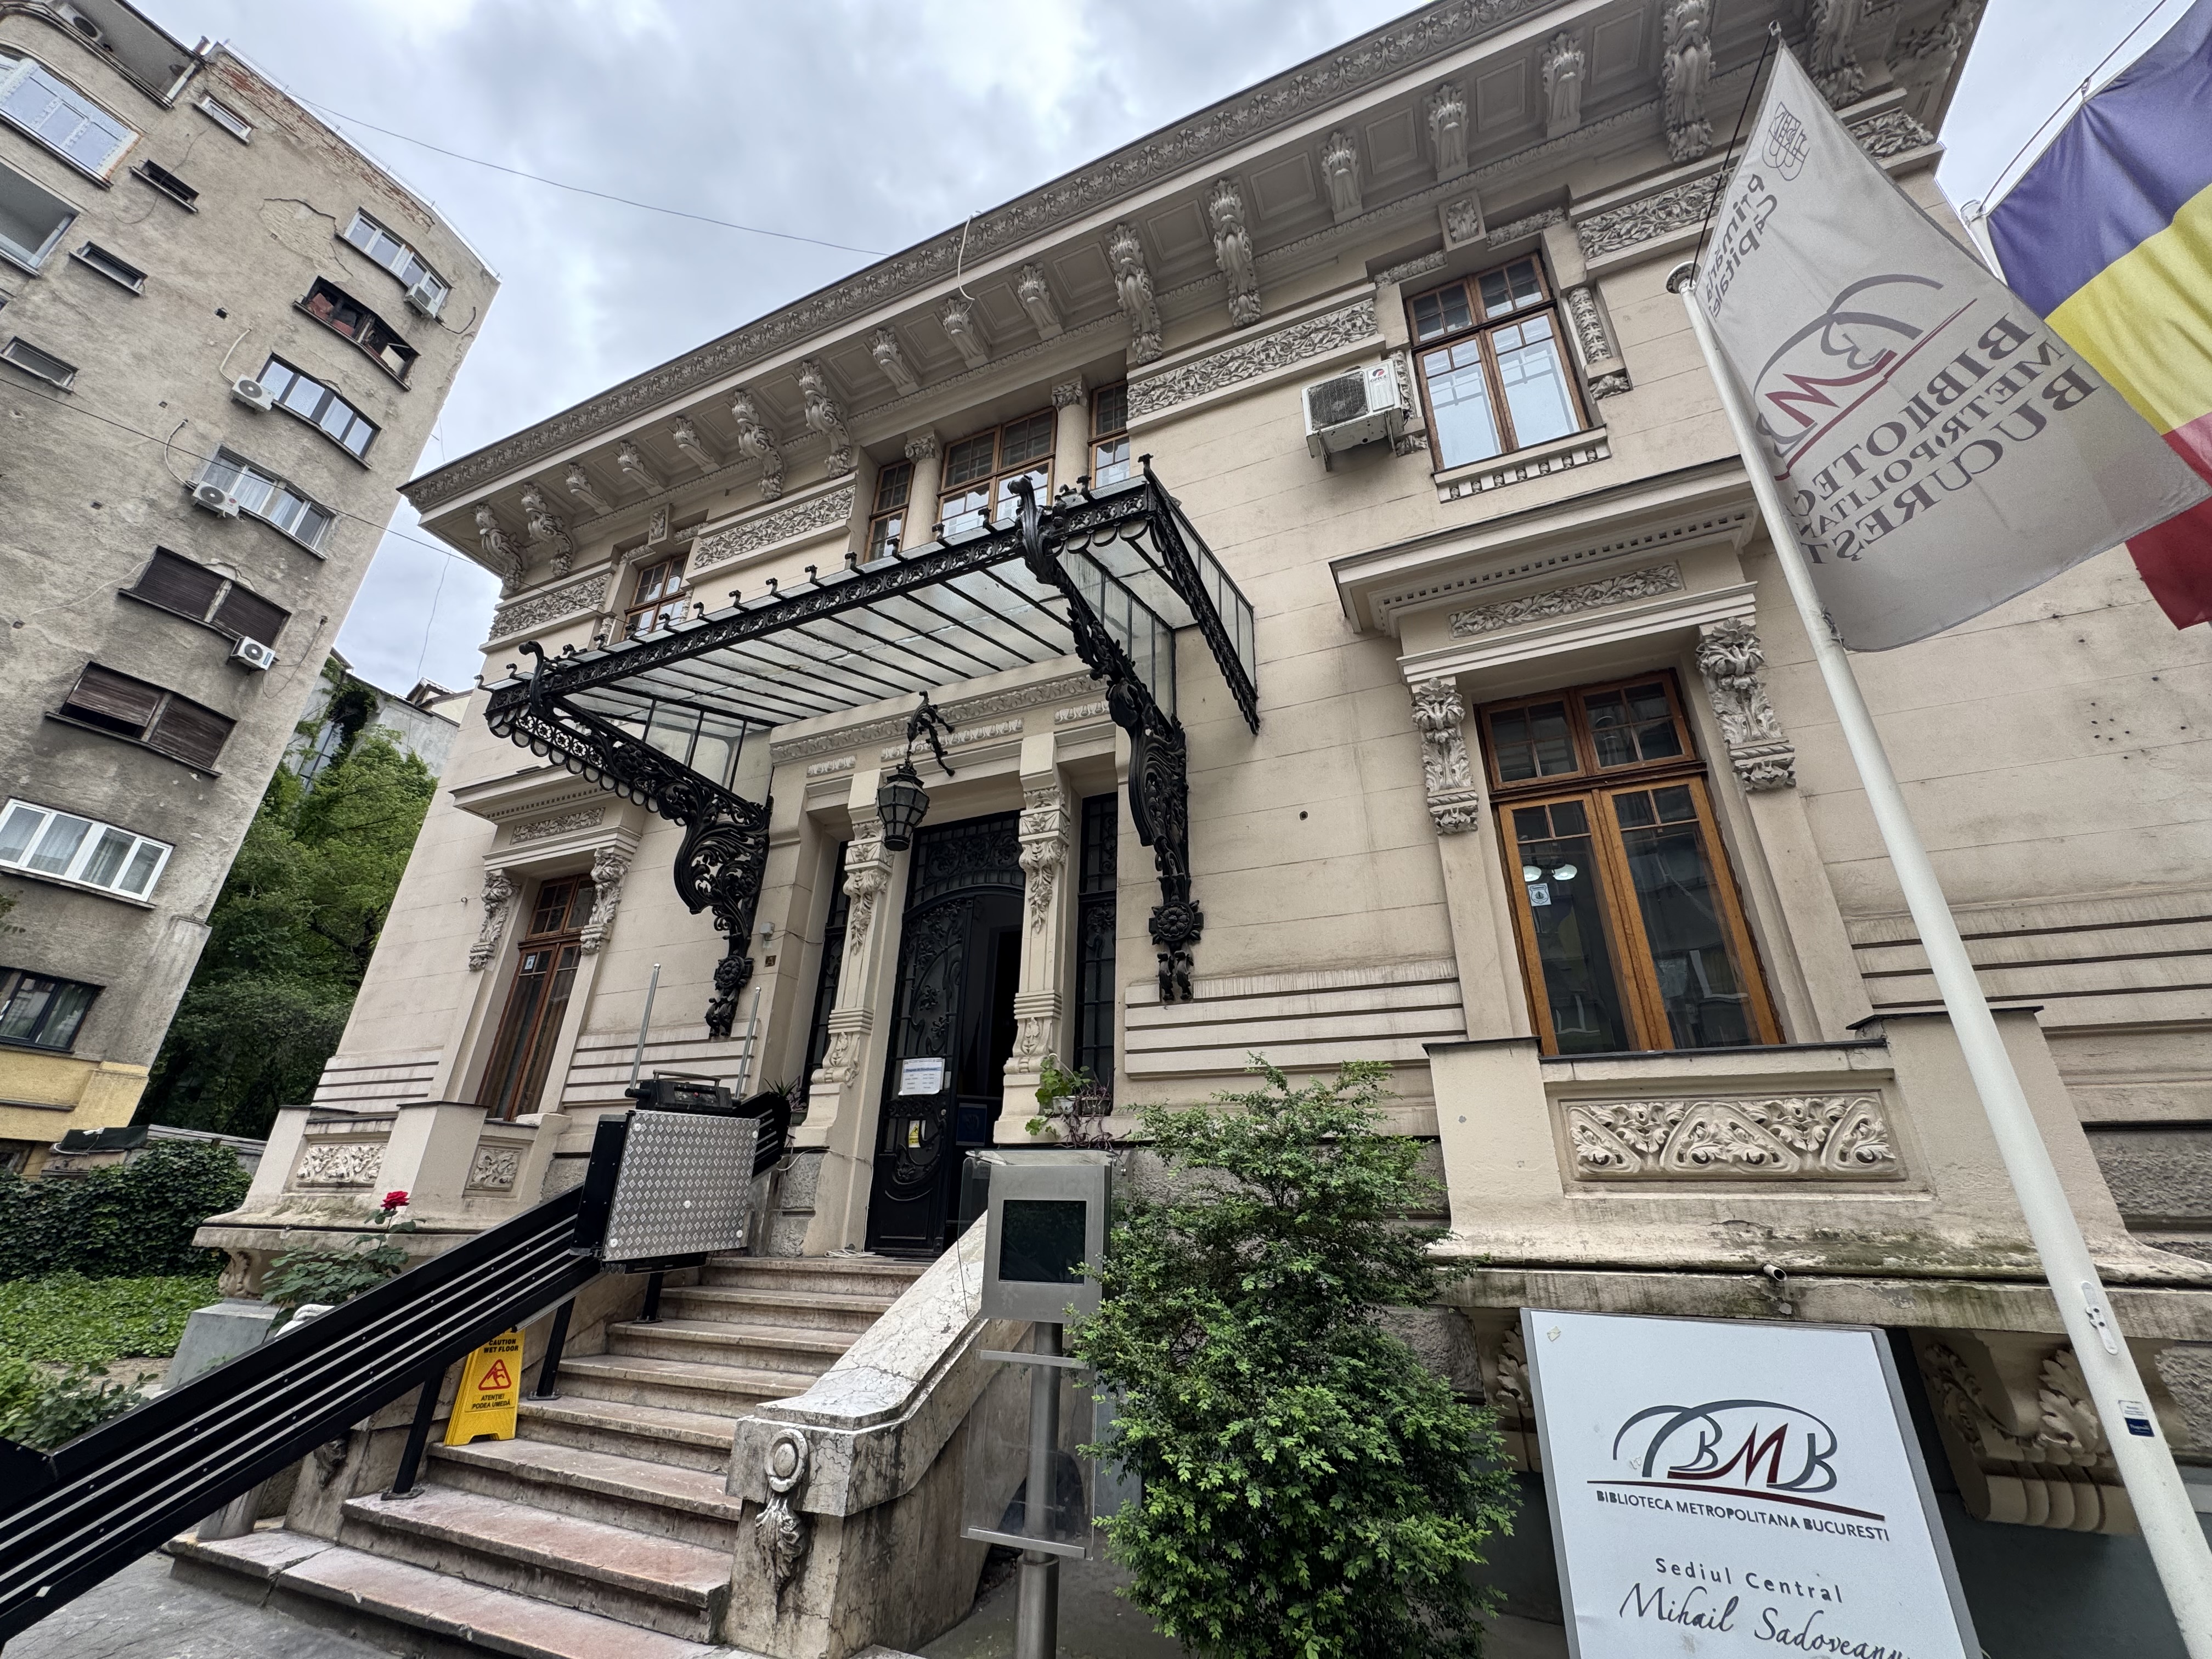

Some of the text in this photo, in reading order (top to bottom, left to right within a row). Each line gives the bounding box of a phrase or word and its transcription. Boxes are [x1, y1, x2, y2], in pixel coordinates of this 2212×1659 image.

[471, 1401, 490, 1409] PODEA
[1596, 1490, 1890, 1542] BIBLIOTECA METROPOLITANA BUCURESTI
[1655, 1558, 1842, 1603] Sediul Central
[1620, 1583, 1739, 1632] Mihail
